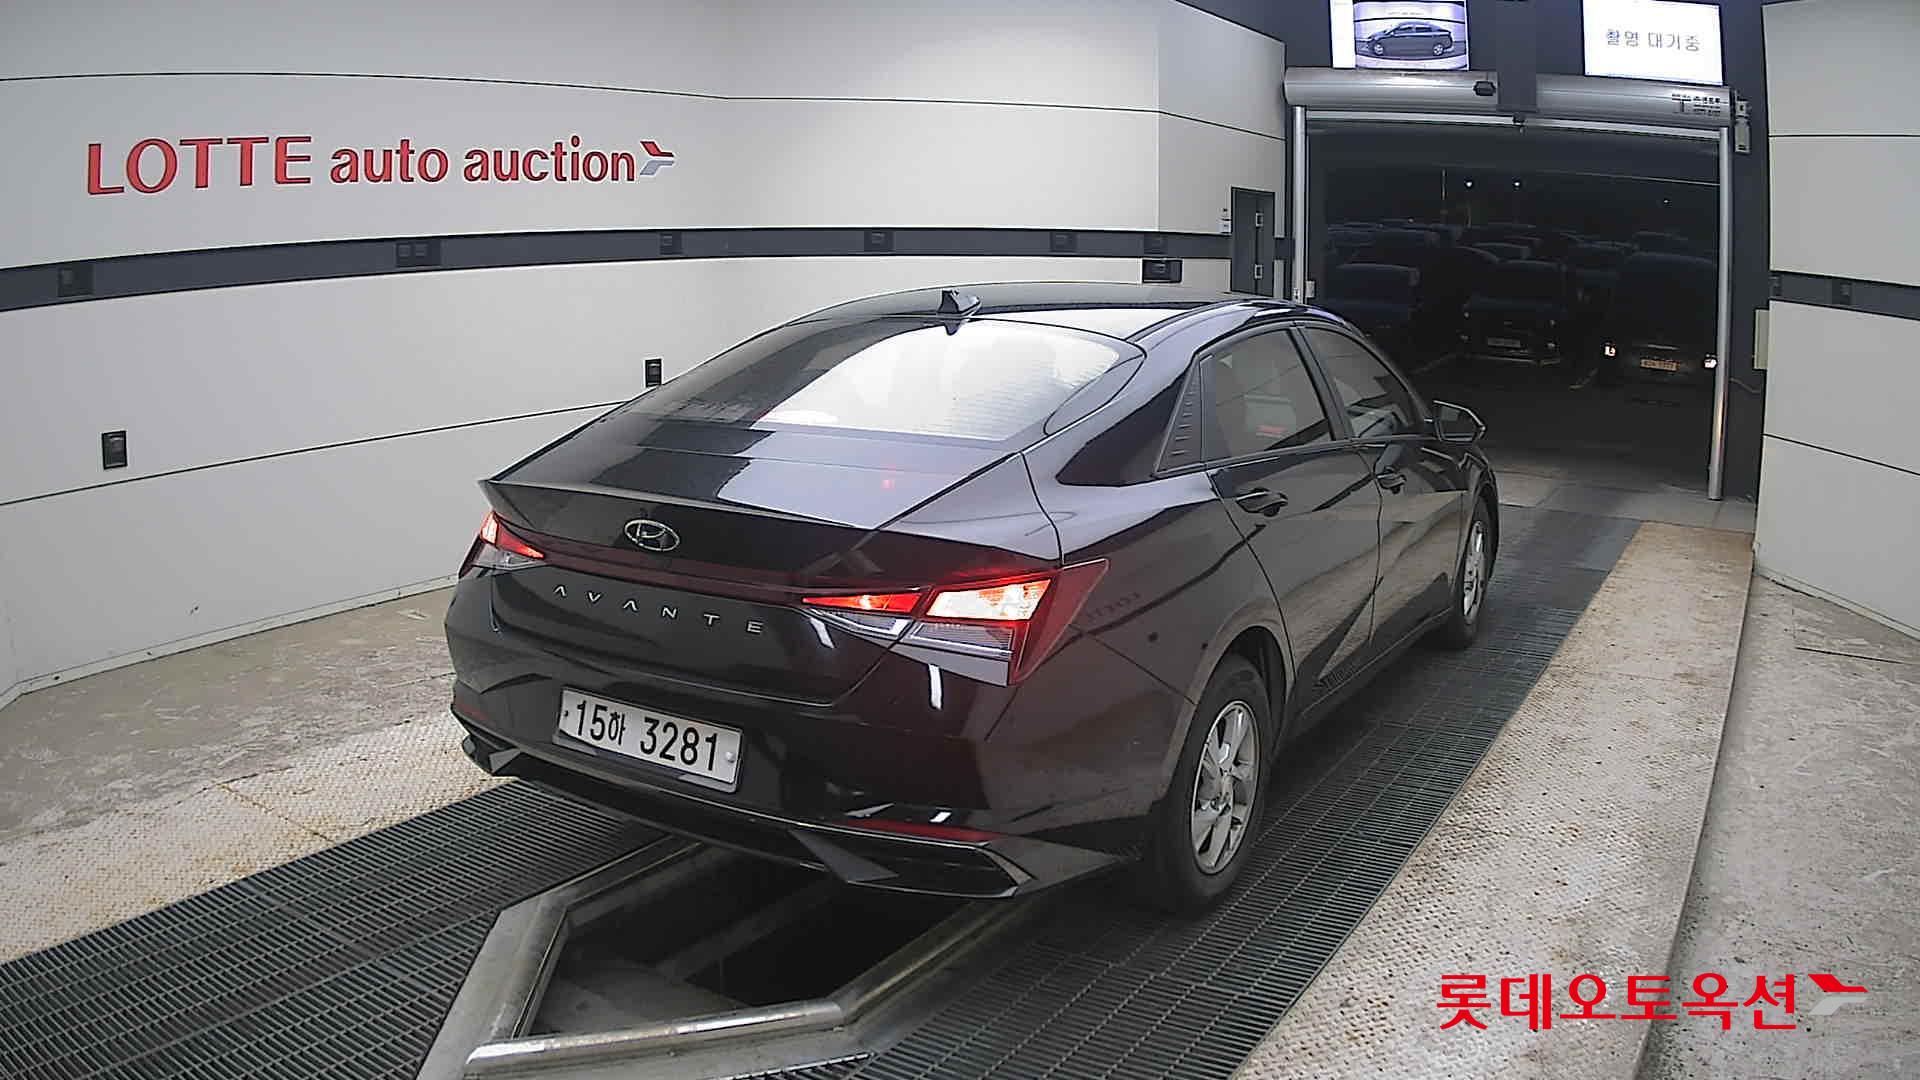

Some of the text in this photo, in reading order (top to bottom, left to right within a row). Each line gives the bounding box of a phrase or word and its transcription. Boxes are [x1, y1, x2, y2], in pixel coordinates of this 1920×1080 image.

[1647, 32, 1700, 51] 대기중
[88, 135, 636, 195] LOTTE auto auction
[554, 585, 764, 633] AVANTE
[576, 700, 718, 771] 15하 3281
